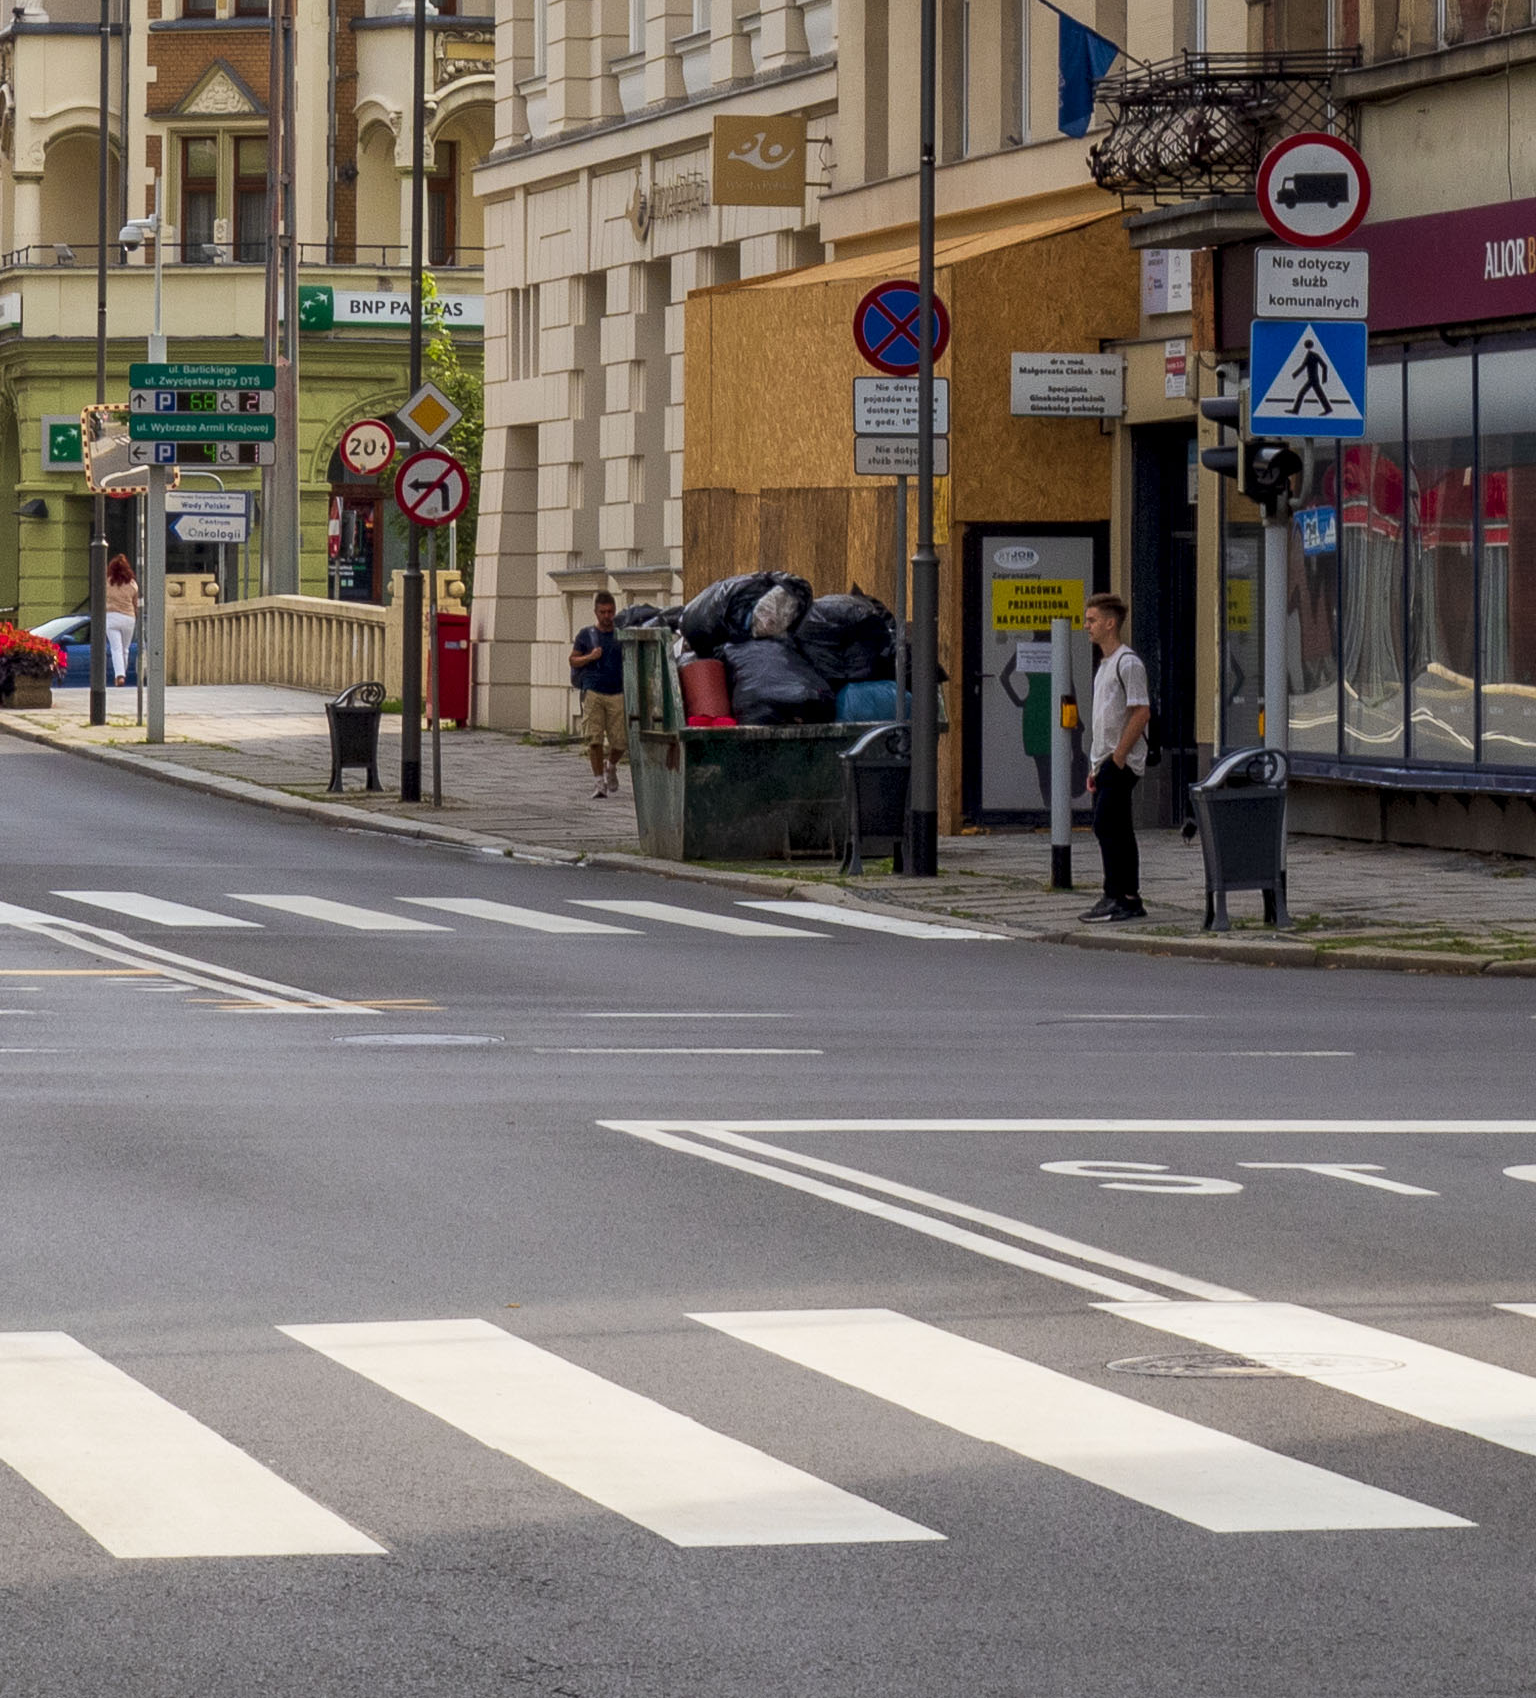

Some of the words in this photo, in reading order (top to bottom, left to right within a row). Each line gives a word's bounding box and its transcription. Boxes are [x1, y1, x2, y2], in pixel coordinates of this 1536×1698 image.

[1484, 237, 1527, 280] ALIOR
[1272, 256, 1294, 269] Nie
[1298, 257, 1351, 273] dotyczy
[1292, 275, 1328, 287] służb
[1269, 294, 1360, 310] komunalnych
[349, 300, 386, 315] BNP
[390, 300, 464, 317] PAIBAS
[182, 365, 237, 376] Barlickiego
[144, 377, 157, 385] ul.
[158, 376, 215, 388] Zwycięstwa
[216, 378, 237, 388] przy
[239, 376, 261, 386] DTŚ
[875, 383, 890, 391] Nie
[1048, 385, 1088, 394] Specjalista
[246, 392, 259, 412] 2
[864, 395, 902, 404] pojazdów
[1029, 394, 1070, 404] Ginekolog
[866, 407, 900, 416] dostawy
[1030, 404, 1071, 414] Ginekolog
[1071, 404, 1105, 414] onkolog
[136, 423, 148, 432] ul.
[150, 423, 198, 434] Wybrzeże
[198, 423, 225, 432] Armii
[226, 422, 269, 434] Krajowej
[203, 444, 216, 462] 4
[875, 445, 891, 454] Nie
[181, 502, 202, 511] Wody
[204, 501, 231, 511] Polskie
[198, 517, 231, 526] Centrum
[188, 528, 241, 541] Onkologii
[1014, 585, 1062, 595] PLACÓWKA
[1007, 600, 1069, 609] PRZENIESIONA
[996, 614, 1008, 624] NA
[1009, 614, 1032, 624] PLAC
